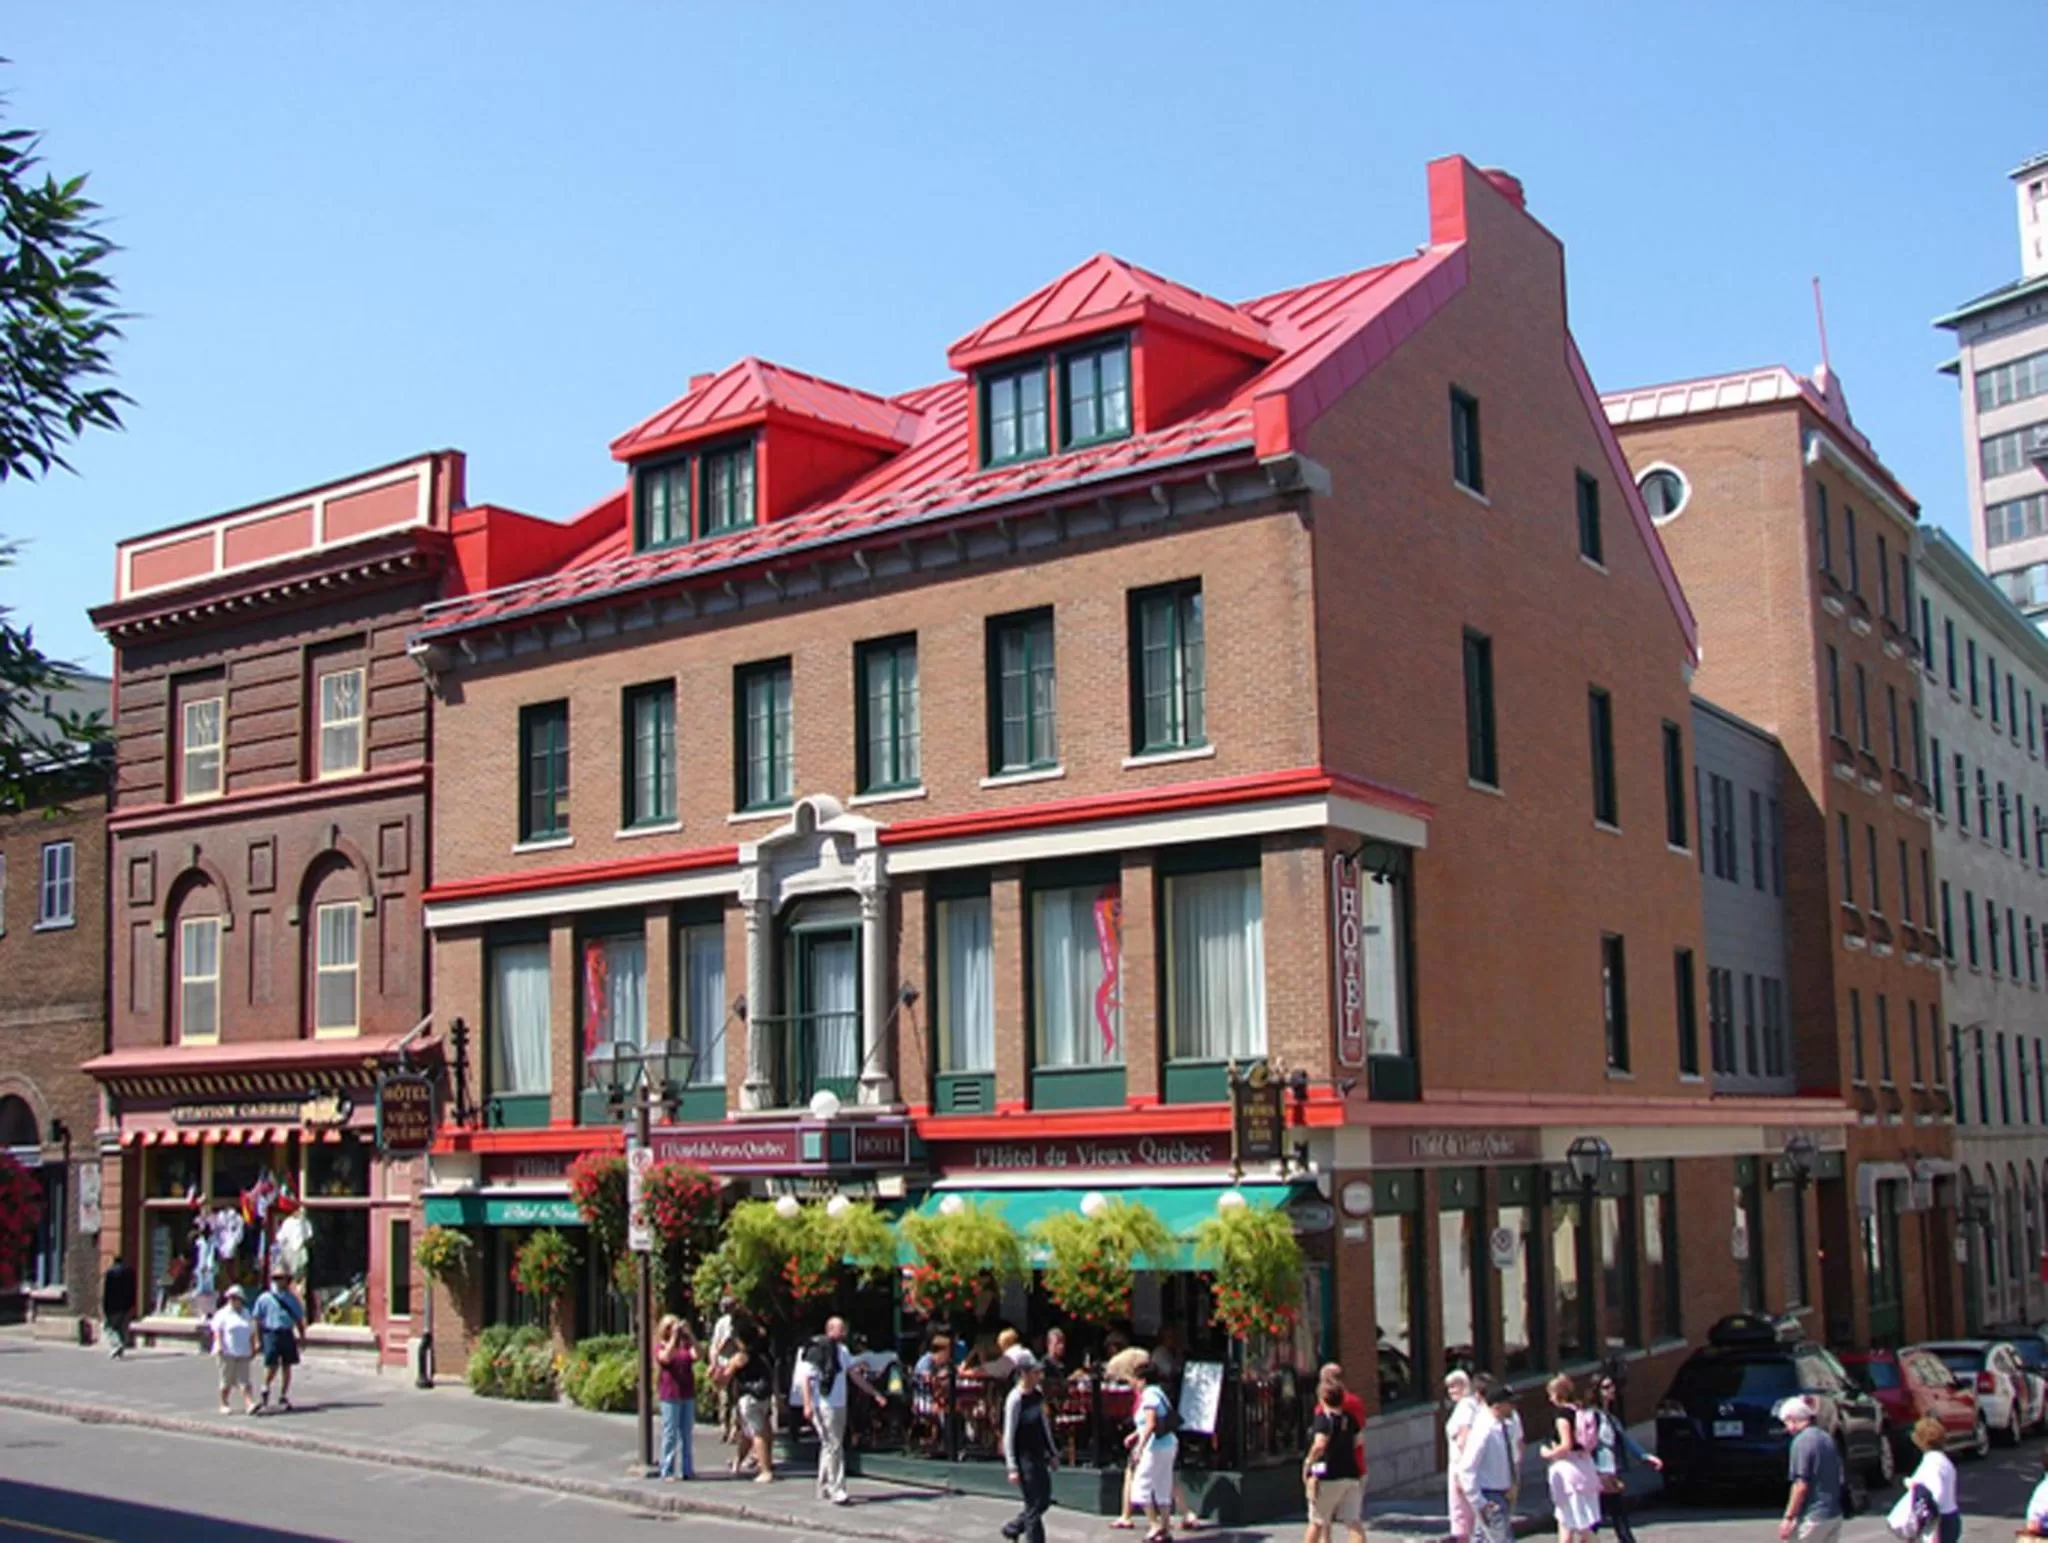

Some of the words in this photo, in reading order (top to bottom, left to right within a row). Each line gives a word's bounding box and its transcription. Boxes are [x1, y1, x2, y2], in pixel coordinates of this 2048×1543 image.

[1044, 1145, 1067, 1167] du
[1075, 1142, 1132, 1166] Vieux
[1138, 1136, 1212, 1165] Québec
